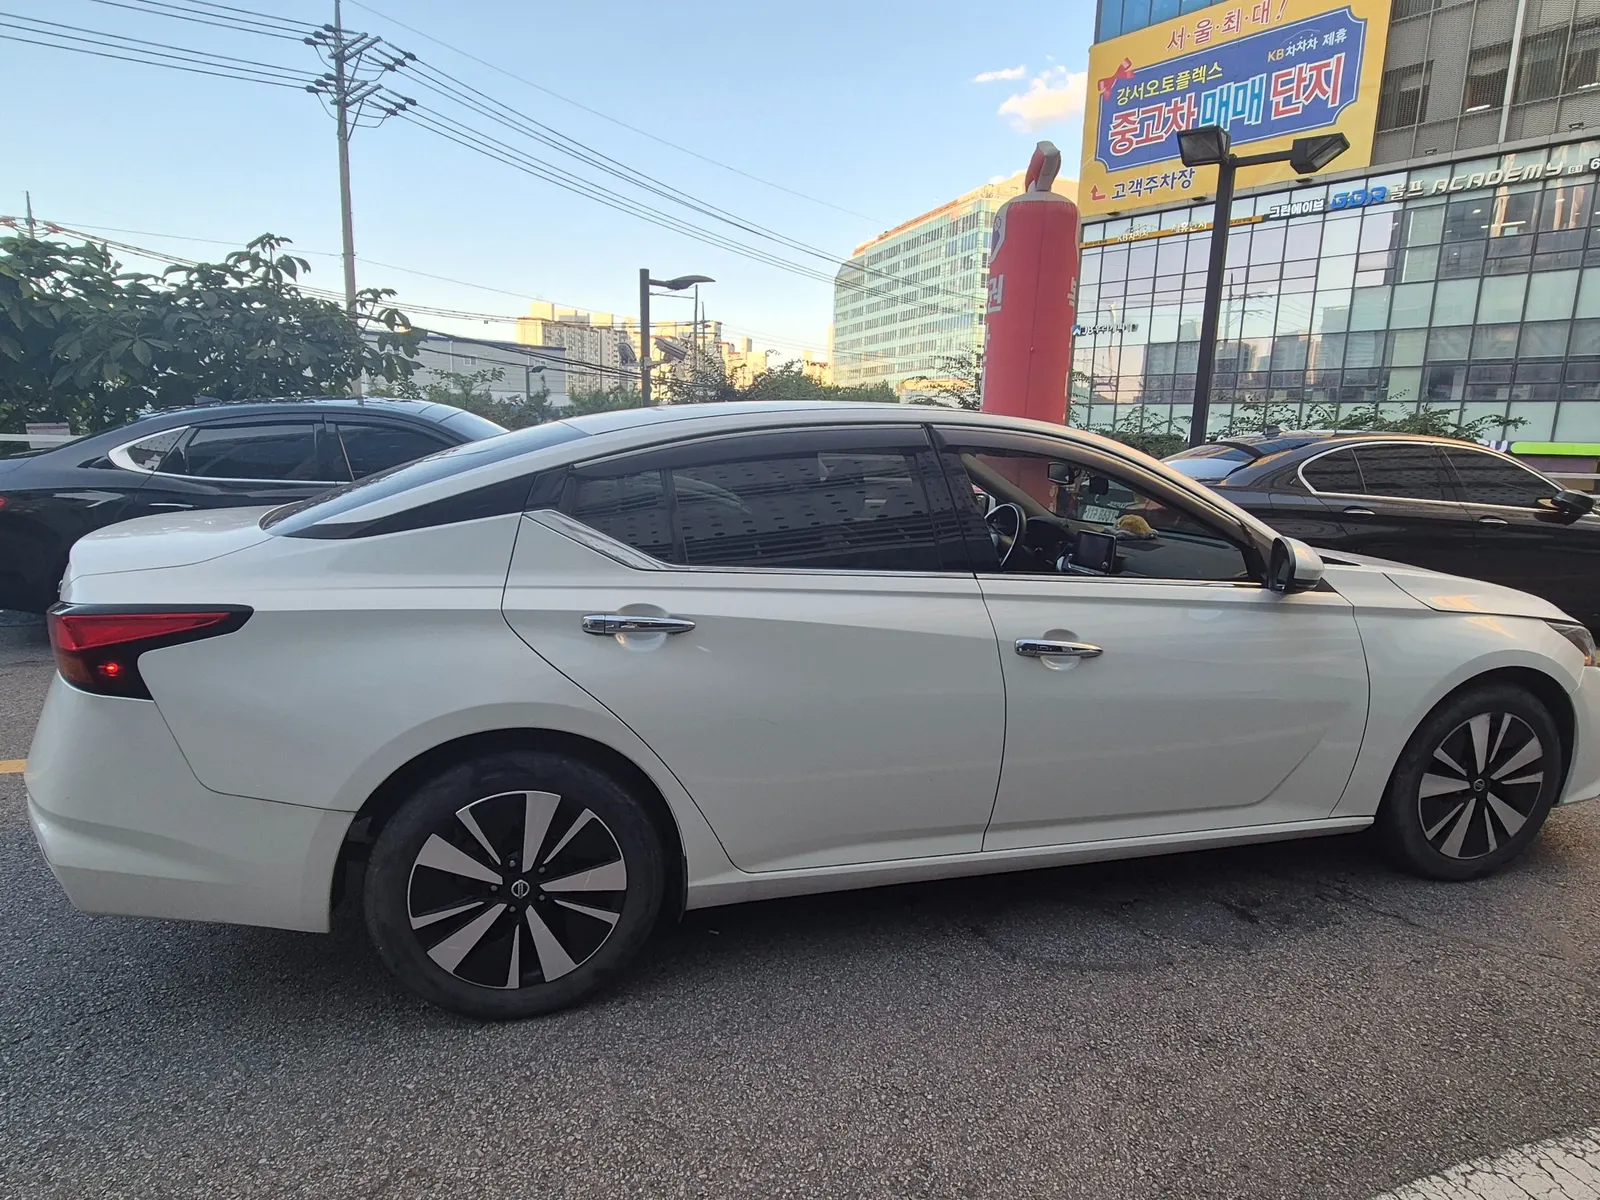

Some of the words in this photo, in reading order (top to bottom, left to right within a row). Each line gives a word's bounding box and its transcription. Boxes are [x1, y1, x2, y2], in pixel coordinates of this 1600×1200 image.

[1267, 33, 1318, 62] KB차차차
[1322, 28, 1347, 46] 제휴
[1116, 61, 1223, 106] 강서오토플렉스
[1109, 94, 1197, 156] 중고차
[1199, 72, 1267, 131] 매매
[1270, 56, 1344, 120] 단지
[1111, 167, 1195, 199] 고객주차장
[1431, 161, 1563, 195] ACADEMY
[1269, 199, 1324, 218] 그린에이브
